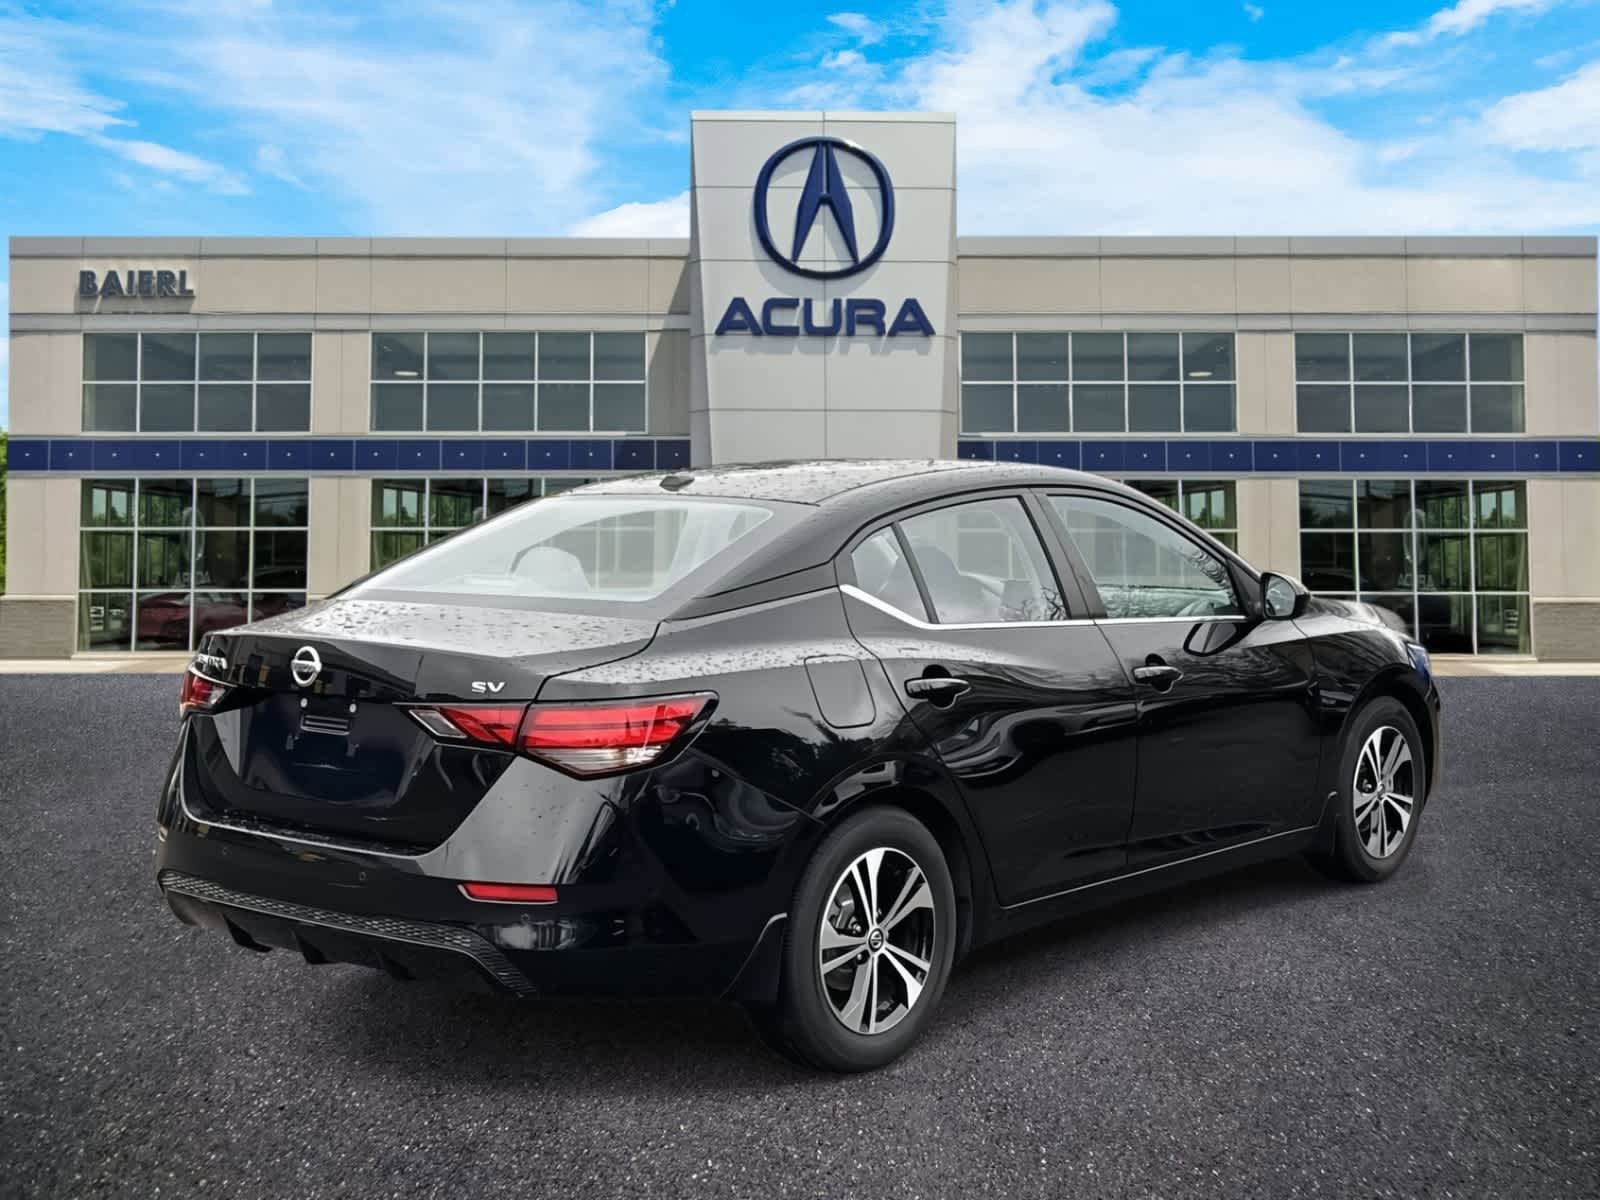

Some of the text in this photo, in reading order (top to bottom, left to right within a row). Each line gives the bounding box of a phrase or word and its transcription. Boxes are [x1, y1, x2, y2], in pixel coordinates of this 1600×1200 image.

[79, 269, 195, 297] BAIERL
[715, 297, 936, 336] ACURA
[471, 681, 505, 693] SV
